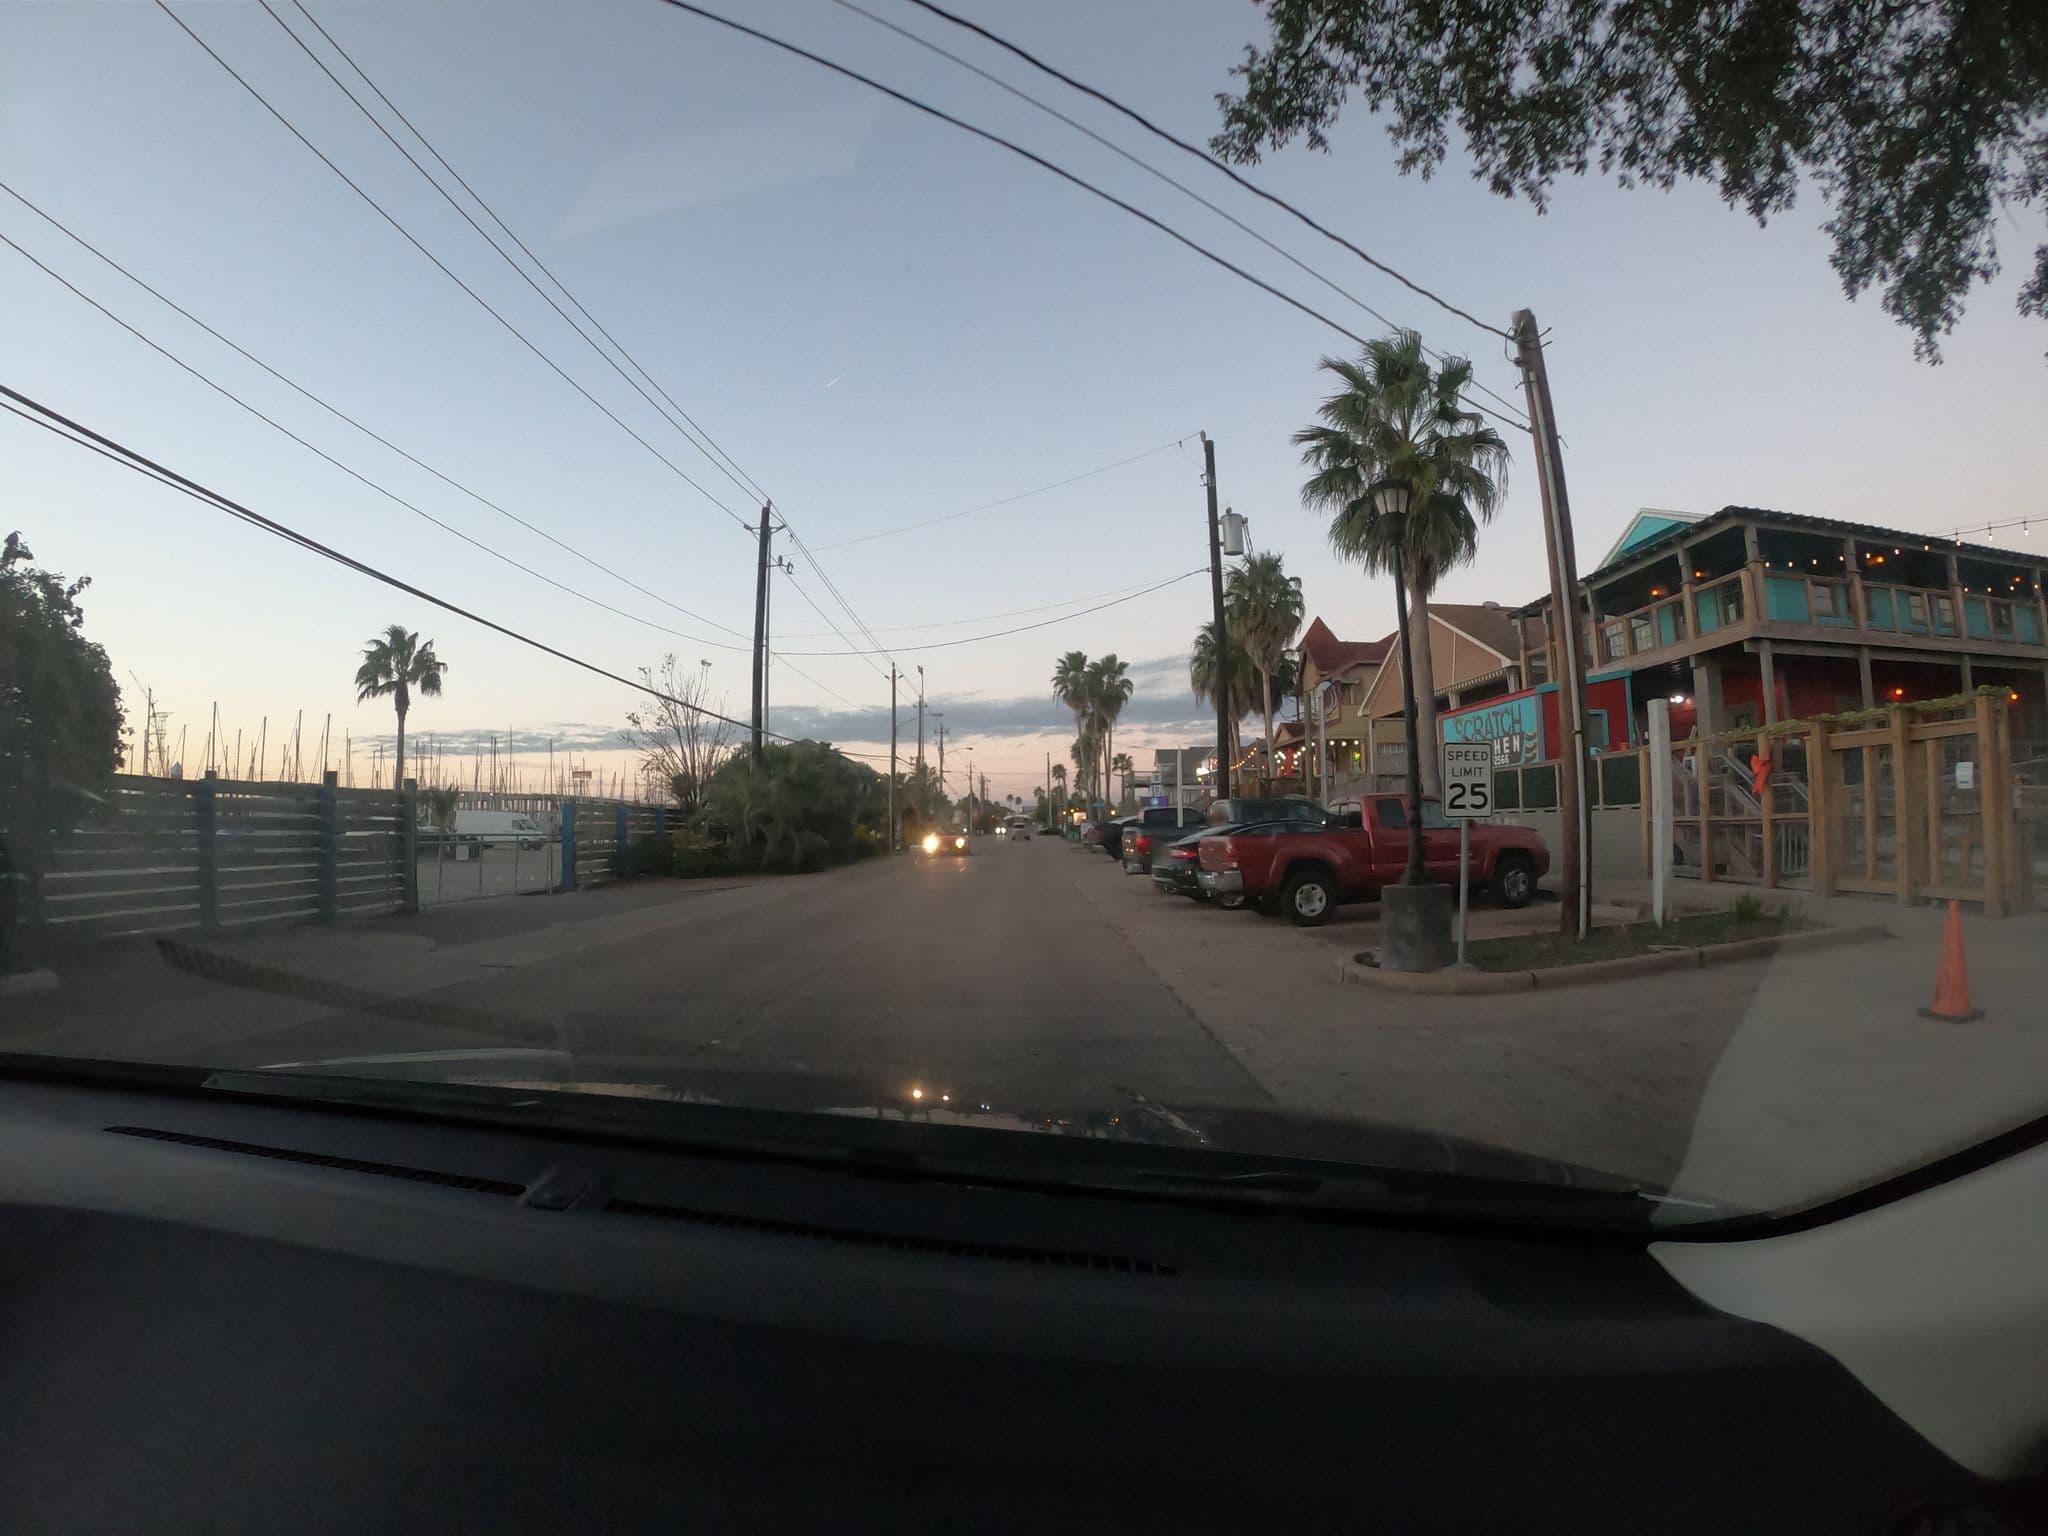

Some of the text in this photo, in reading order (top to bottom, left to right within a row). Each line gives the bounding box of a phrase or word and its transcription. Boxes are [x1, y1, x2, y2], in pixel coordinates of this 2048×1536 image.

[1453, 703, 1523, 741] SCRATCH
[1447, 750, 1489, 761] SPEED
[1451, 767, 1484, 777] LIMIT
[1448, 782, 1488, 810] 25
